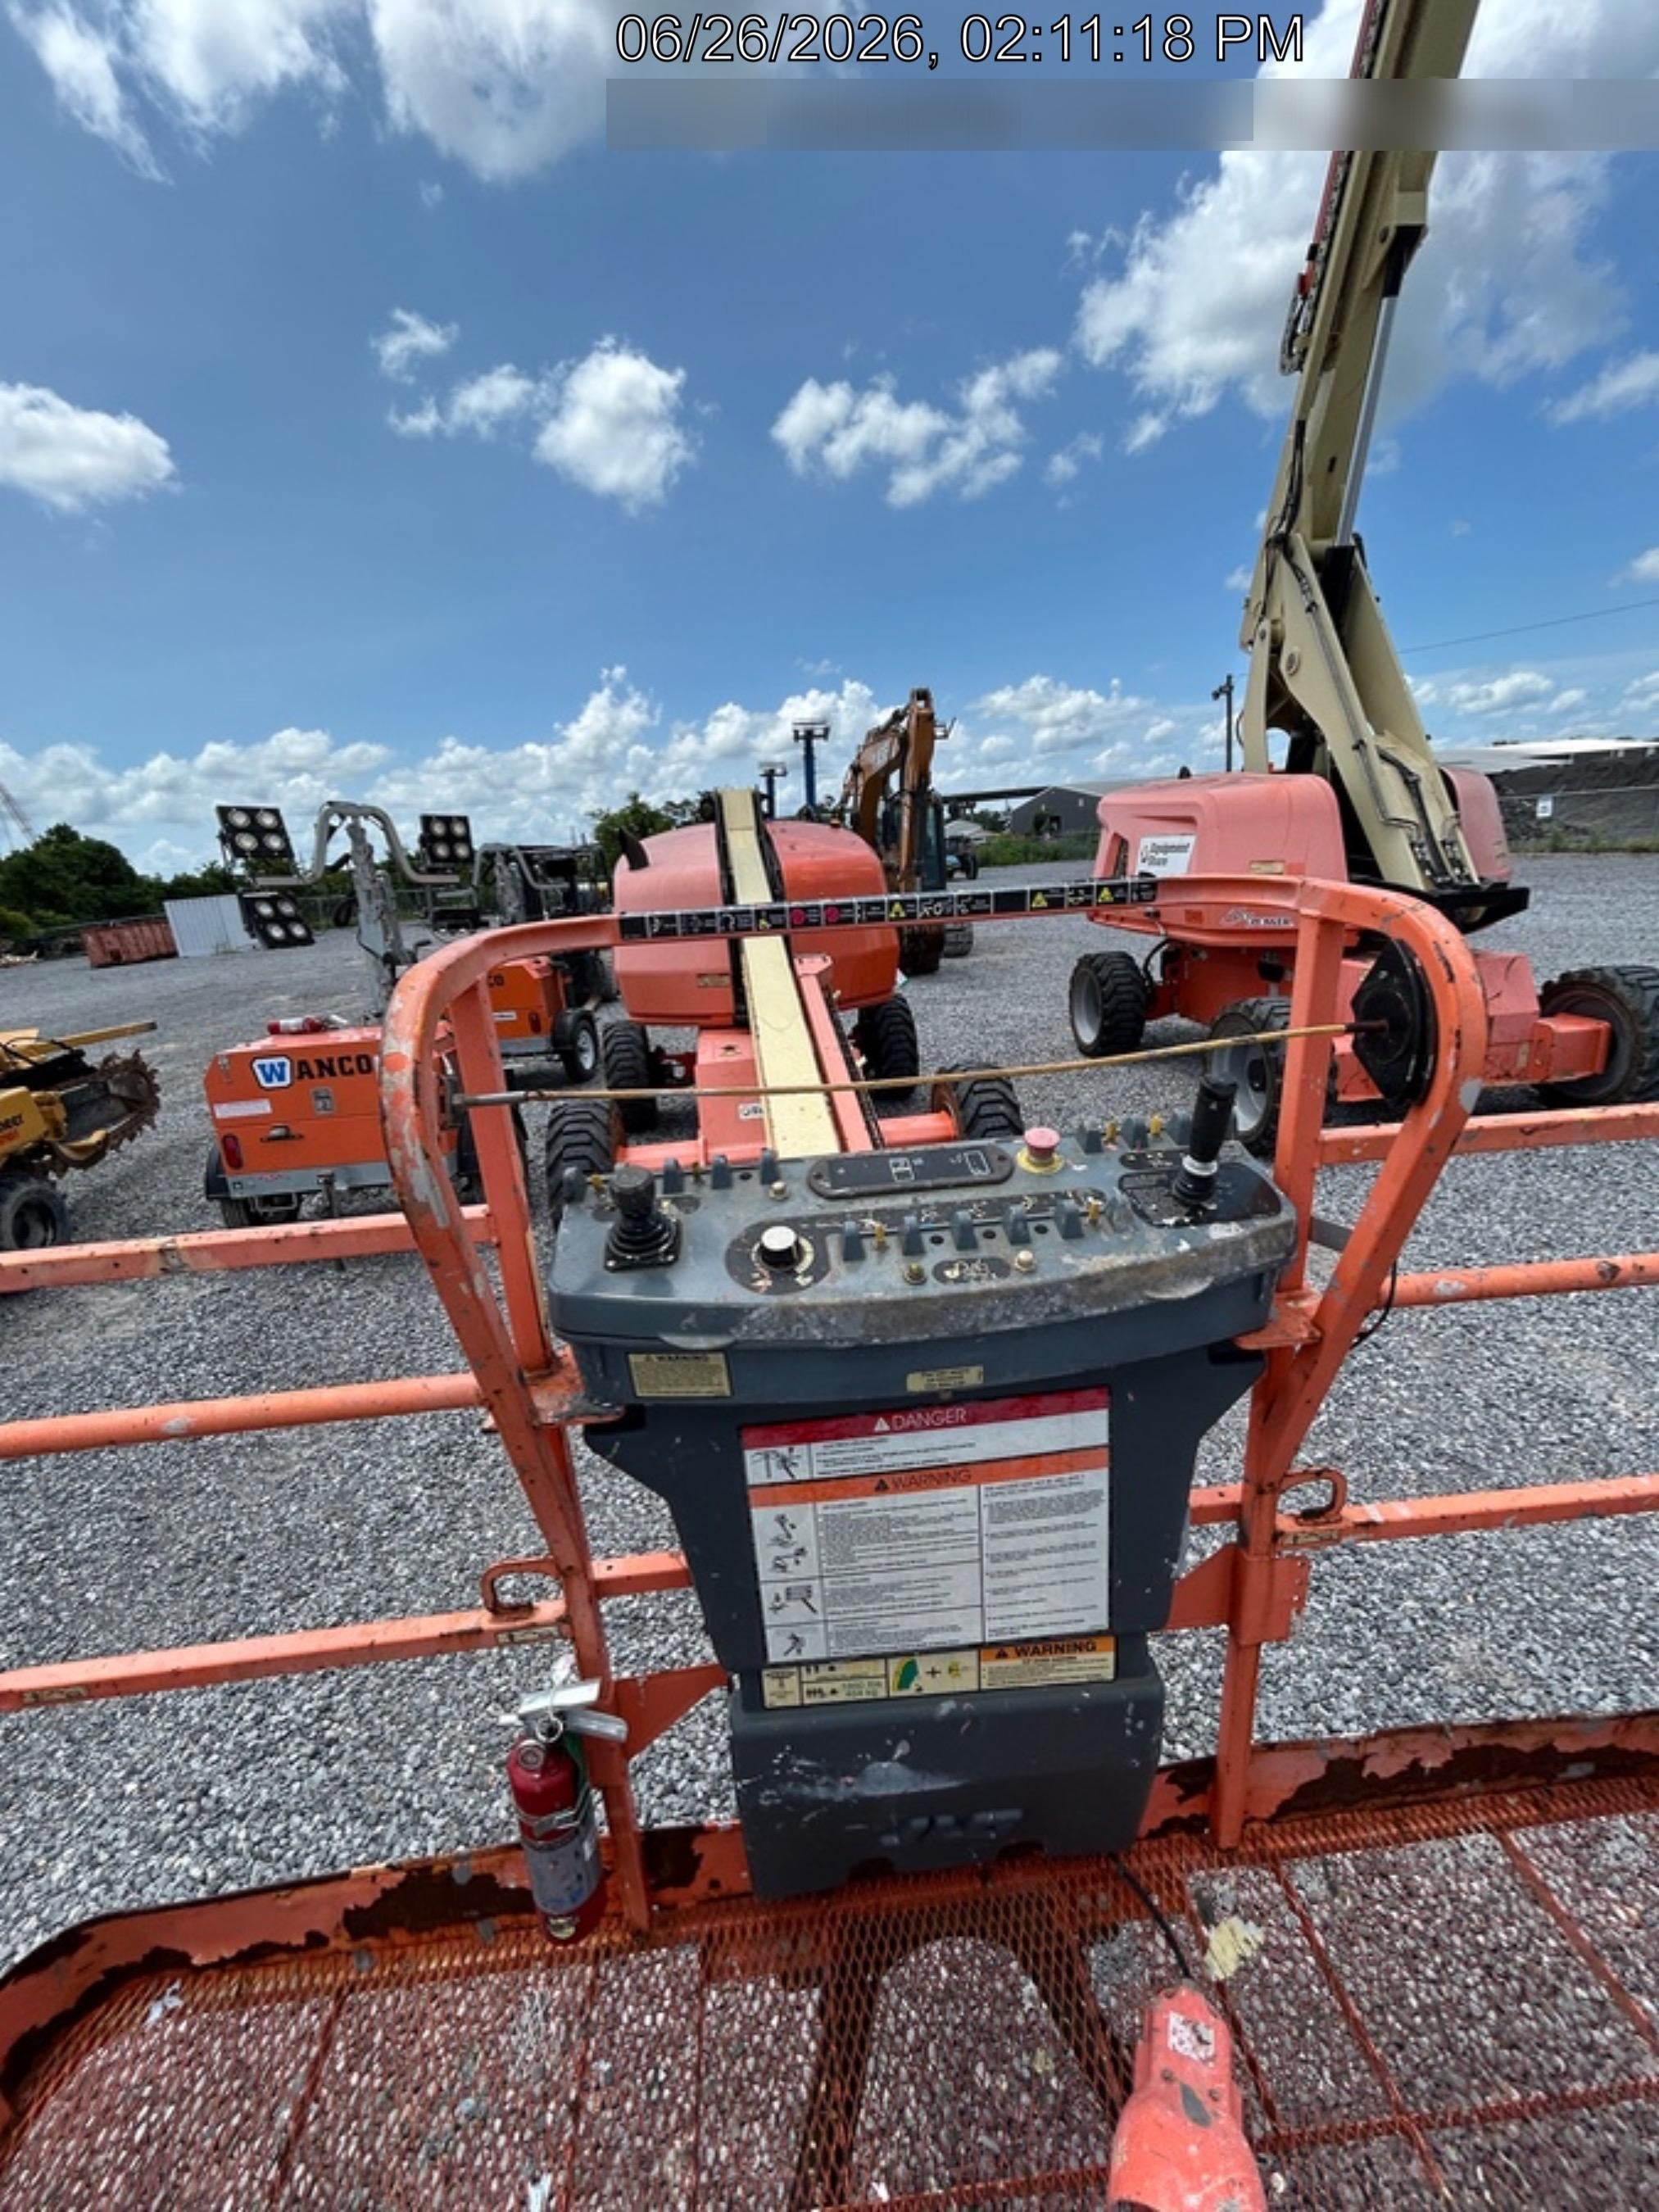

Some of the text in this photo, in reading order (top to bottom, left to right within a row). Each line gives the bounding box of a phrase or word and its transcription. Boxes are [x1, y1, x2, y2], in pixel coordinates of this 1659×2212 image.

[256, 1054, 374, 1085] WANCO
[891, 1407, 968, 1430] DANGER
[891, 1468, 972, 1489] WARNING
[1014, 1639, 1097, 1657] WARNING
